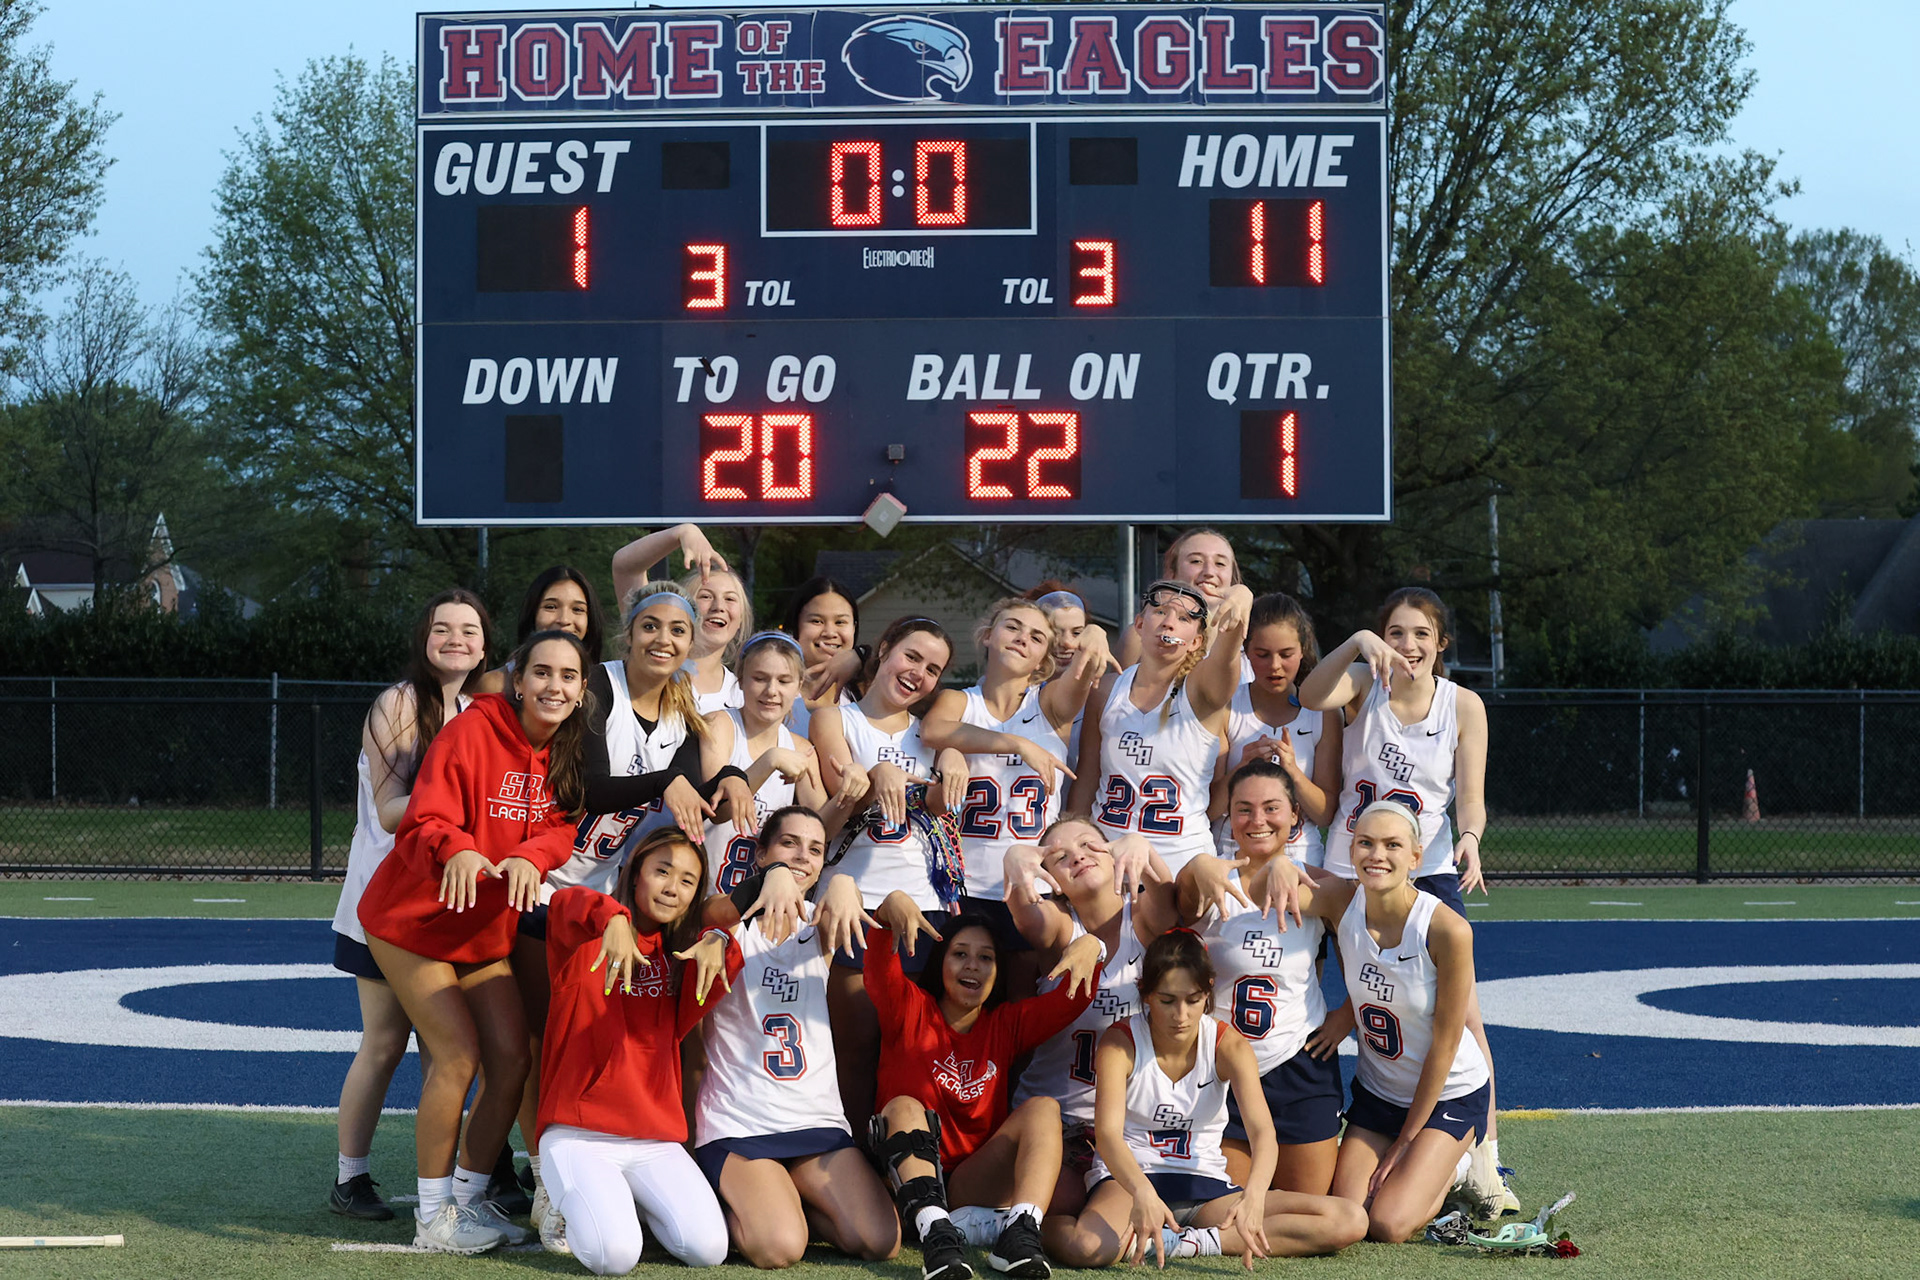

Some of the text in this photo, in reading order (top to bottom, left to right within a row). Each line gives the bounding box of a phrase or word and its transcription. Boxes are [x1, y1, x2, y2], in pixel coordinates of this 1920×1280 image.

[439, 21, 723, 103] HOME
[736, 20, 791, 55] OF
[994, 15, 1385, 96] EAGLES
[737, 60, 825, 95] THE
[434, 140, 631, 196] GUEST
[830, 140, 966, 226] 0:0
[1178, 133, 1354, 188] HOME
[574, 206, 588, 289] 1
[1250, 201, 1324, 285] 11
[686, 244, 726, 309] 3
[744, 280, 796, 307] TOL
[1001, 278, 1054, 304] TOL
[1074, 241, 1115, 305] 3
[462, 357, 618, 404] DOWN
[673, 354, 837, 403] TO GO
[907, 352, 1141, 400] BALL ON
[1206, 351, 1330, 405] QTR.
[704, 414, 812, 500] 20
[969, 413, 1078, 498] 22
[1282, 412, 1295, 497] 1
[1118, 731, 1153, 766] SBA
[1379, 743, 1415, 783] SBA
[959, 775, 1049, 840] 23
[1097, 775, 1184, 835] 22
[716, 834, 760, 895] 8
[1242, 930, 1283, 968] SBA
[762, 966, 799, 1003] SBA
[1231, 975, 1278, 1040] 6
[1359, 963, 1394, 1003] SBA
[762, 1013, 808, 1081] 3
[1359, 1003, 1404, 1061] 9
[1148, 1130, 1192, 1160] 7
